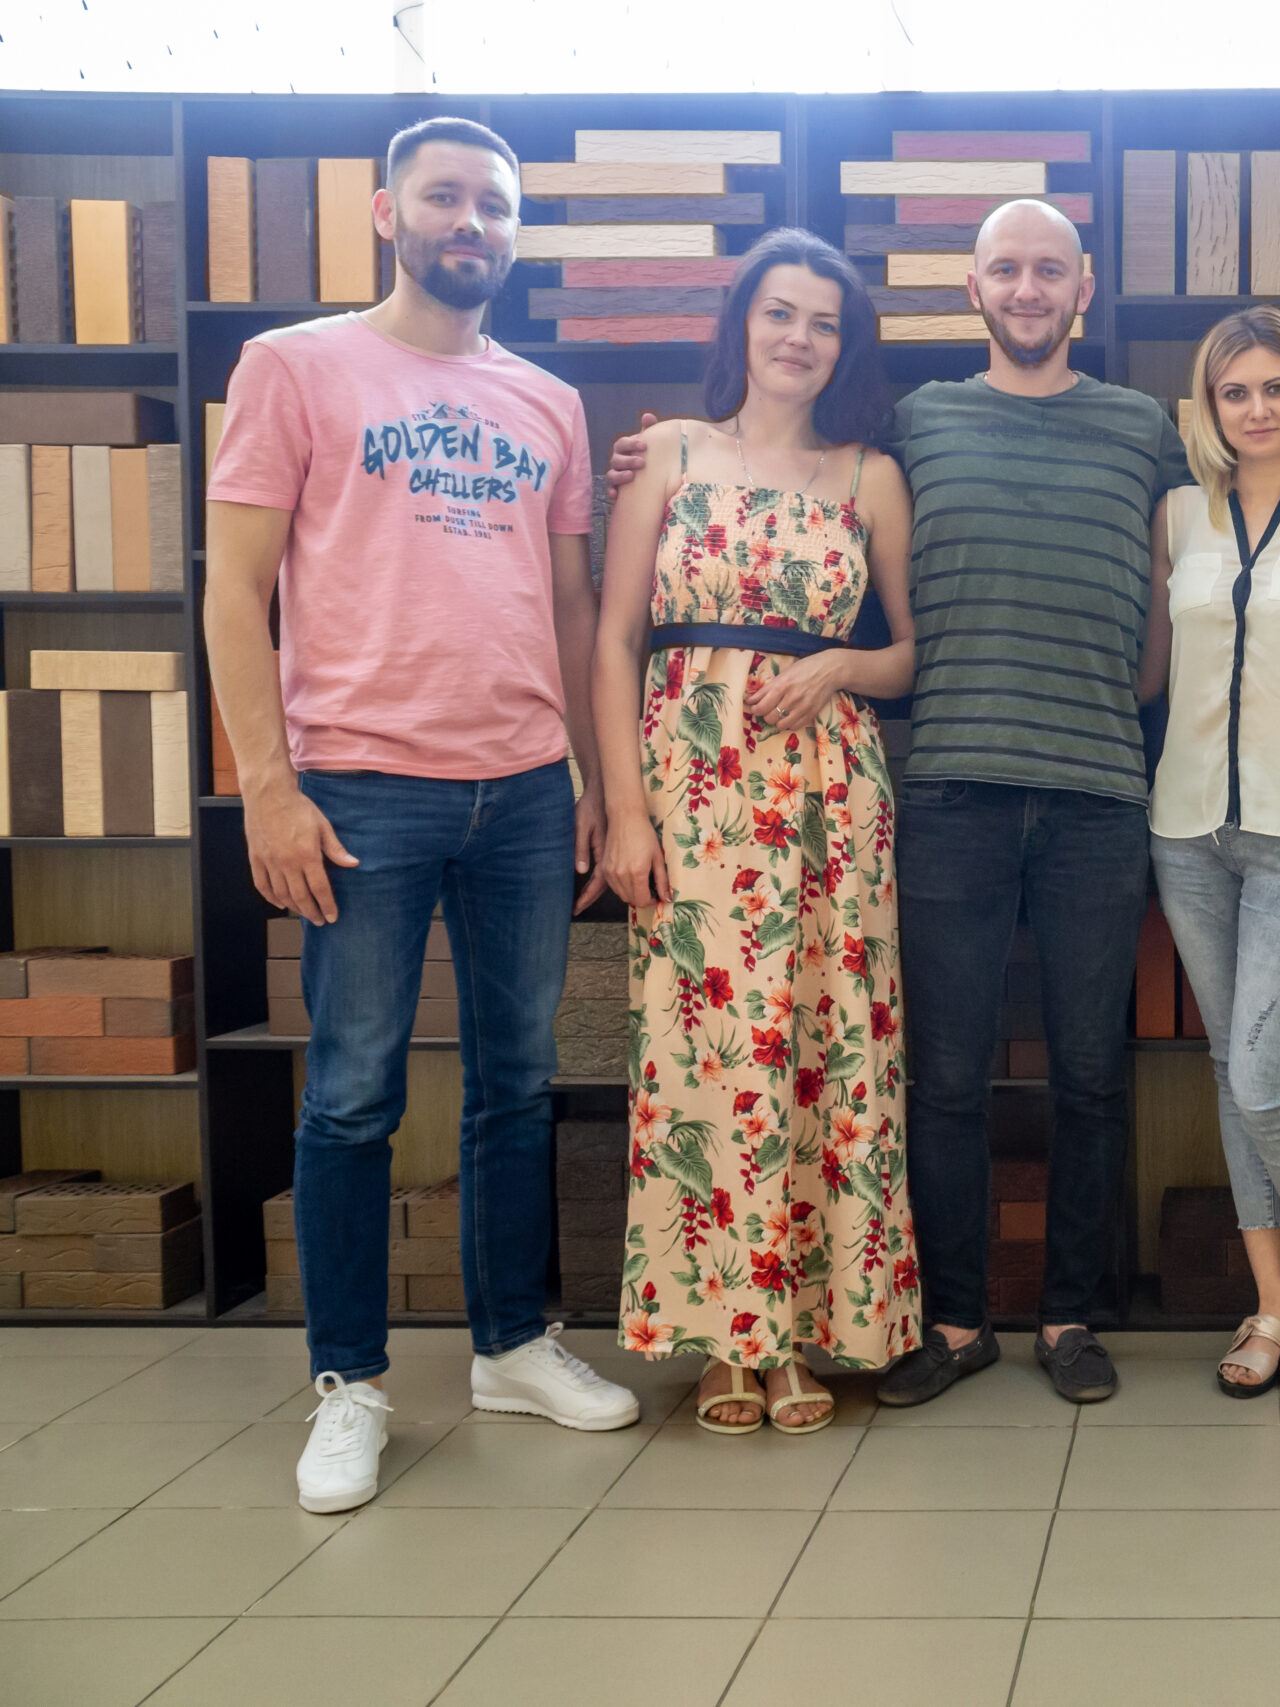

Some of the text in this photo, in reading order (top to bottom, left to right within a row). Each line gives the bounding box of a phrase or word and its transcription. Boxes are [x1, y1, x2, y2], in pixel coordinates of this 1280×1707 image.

[361, 421, 547, 492] GOLDEN BAY
[409, 468, 516, 504] CHILLERS
[447, 506, 481, 518] SURFING
[415, 514, 514, 532] FROM DUSK TILL DOWN
[443, 525, 472, 536] ESTAB.
